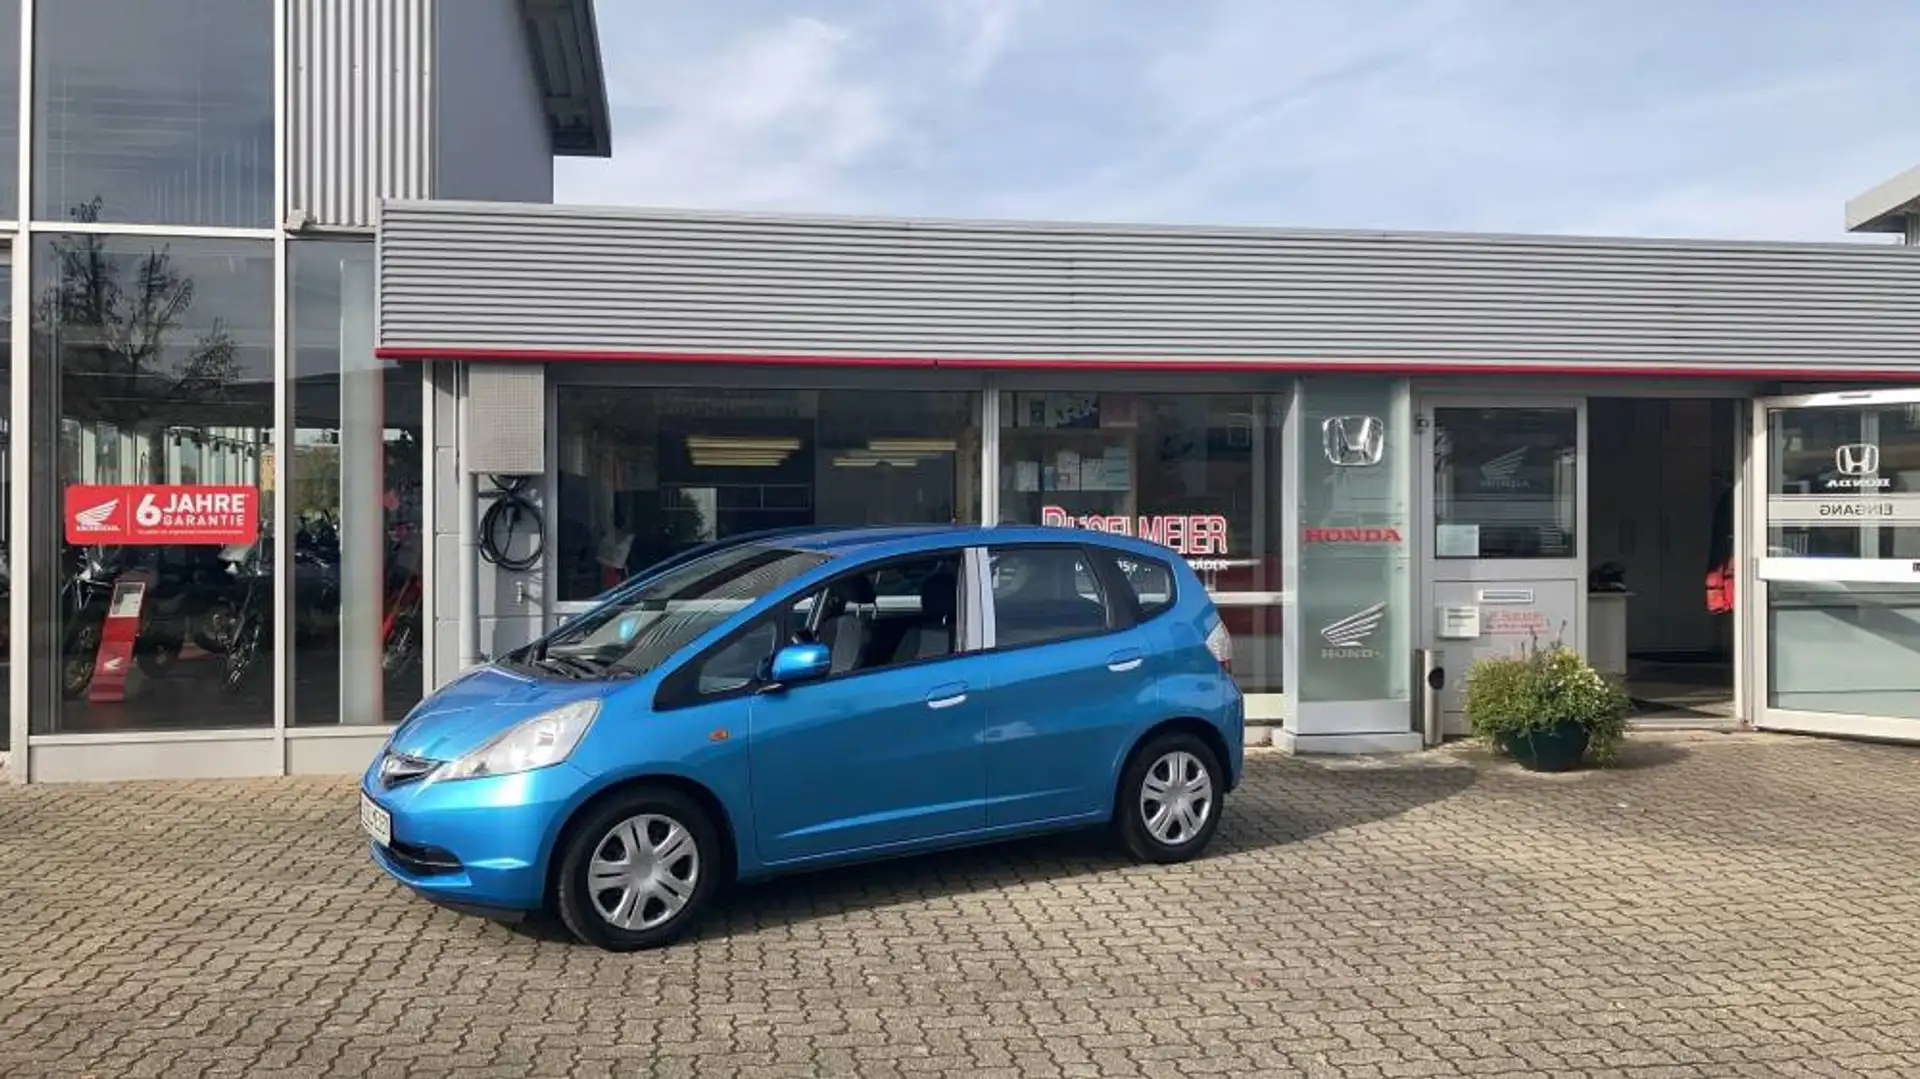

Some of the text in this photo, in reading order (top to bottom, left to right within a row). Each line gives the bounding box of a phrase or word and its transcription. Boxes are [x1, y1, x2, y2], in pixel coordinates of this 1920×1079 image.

[135, 493, 245, 527] 6 JAHRE
[162, 514, 244, 527] GARANTIE
[1304, 529, 1401, 542] HONDA
